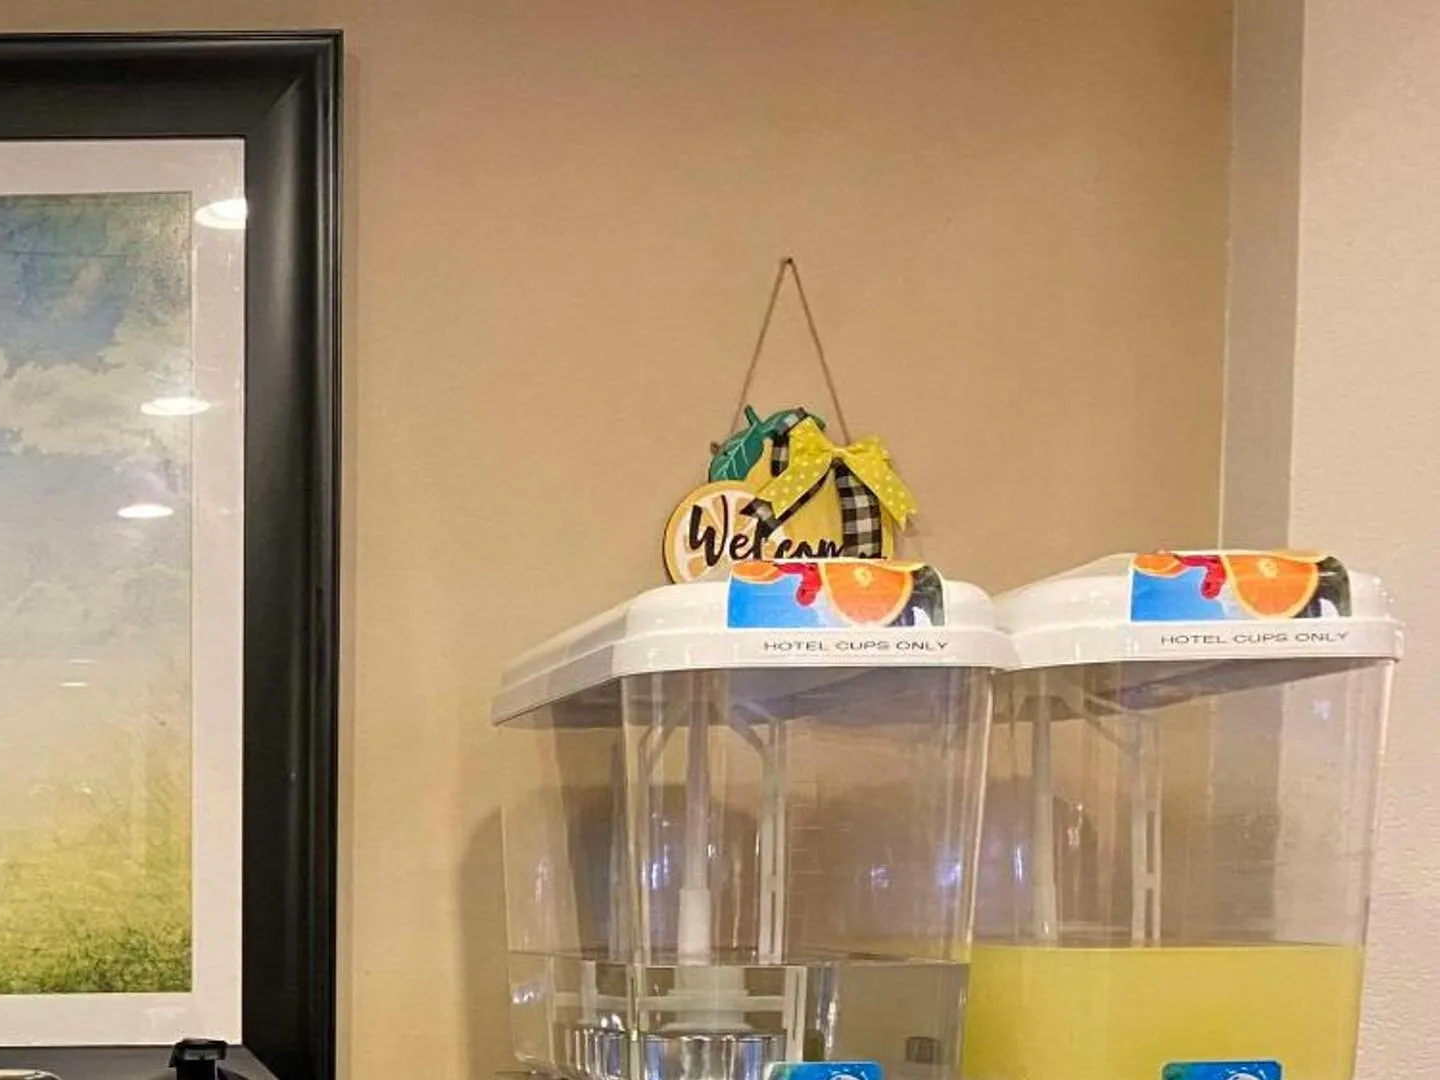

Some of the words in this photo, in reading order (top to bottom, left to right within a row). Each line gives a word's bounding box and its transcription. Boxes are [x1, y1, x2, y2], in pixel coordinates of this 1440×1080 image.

[688, 494, 887, 566] Welcom
[763, 640, 830, 652] HOTEL
[834, 639, 891, 651] CUPS
[895, 639, 949, 651] ONLY
[1160, 634, 1227, 646] HOTEL
[1232, 632, 1288, 645] CUPS
[1294, 631, 1350, 643] ONLY
